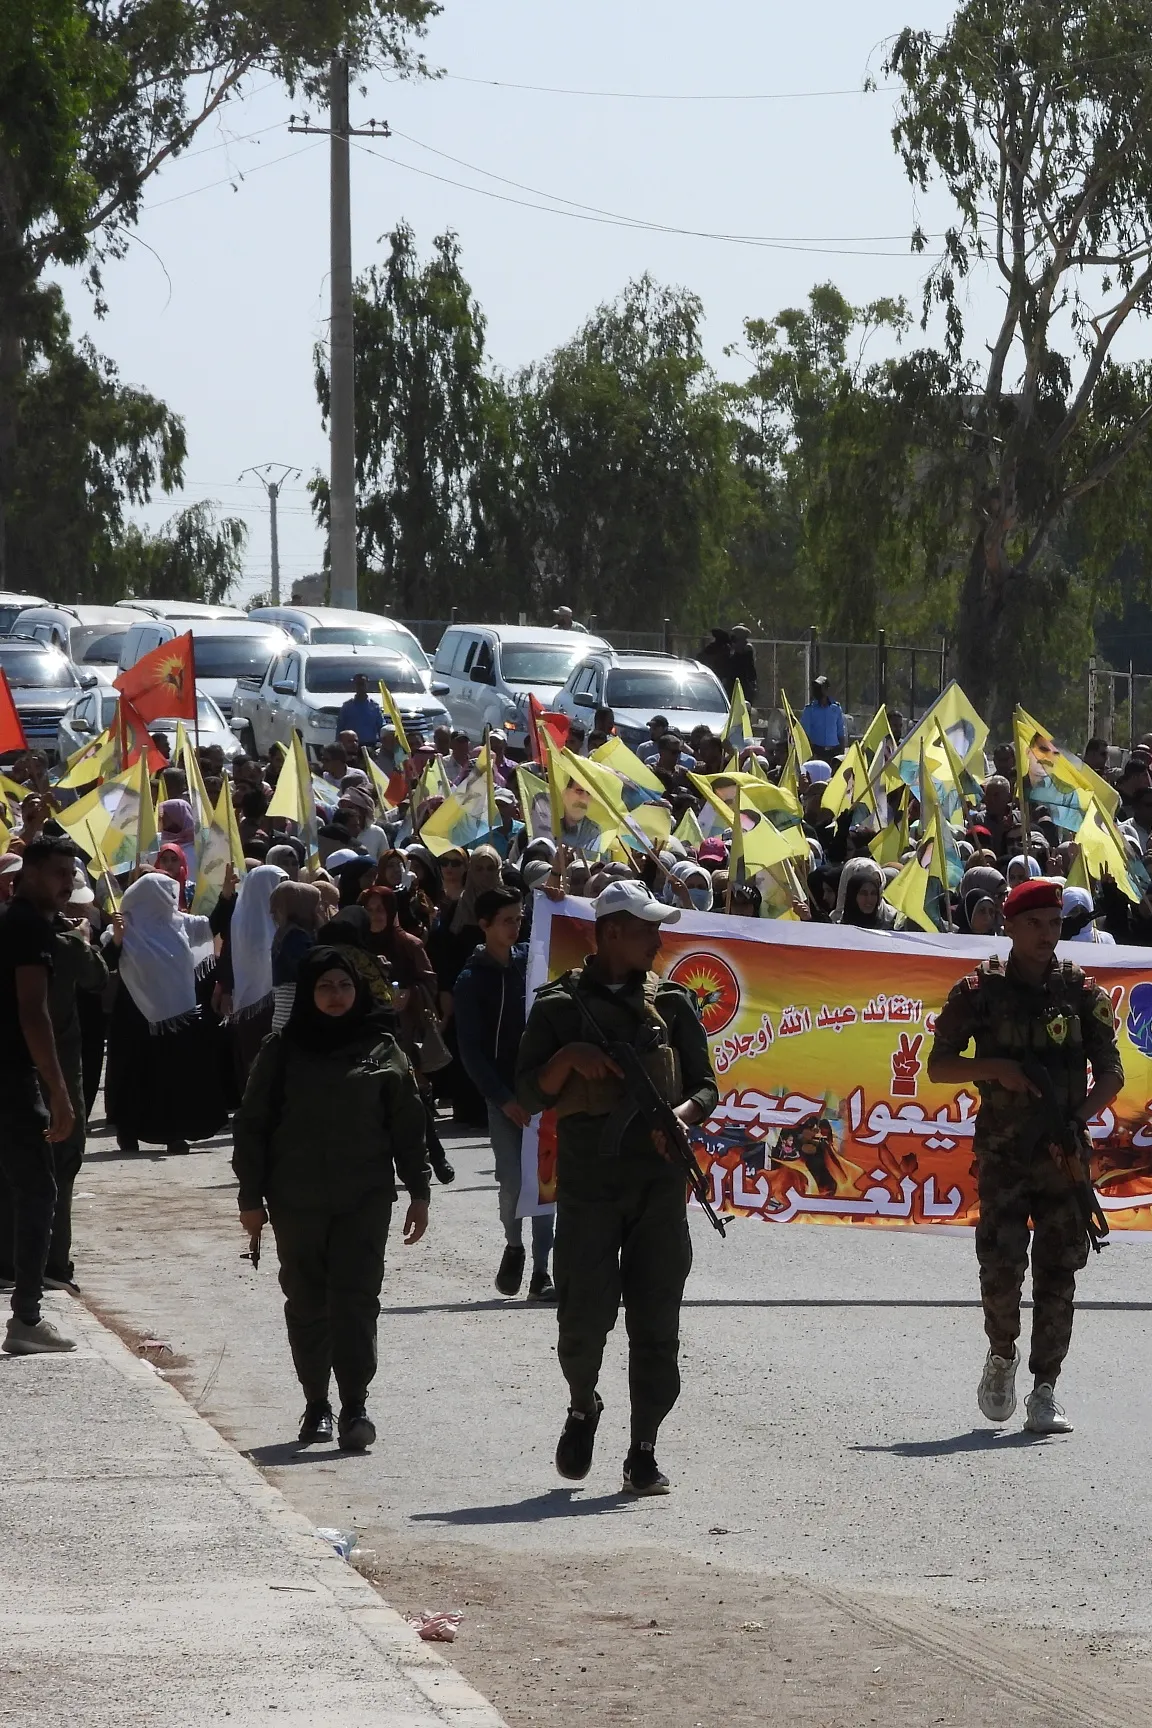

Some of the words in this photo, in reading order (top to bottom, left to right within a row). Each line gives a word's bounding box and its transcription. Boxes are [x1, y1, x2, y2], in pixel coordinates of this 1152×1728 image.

[778, 1004, 812, 1038] الله
[816, 1003, 857, 1032] عبد
[861, 994, 923, 1024] القائد
[713, 1013, 774, 1074] أوجلان
